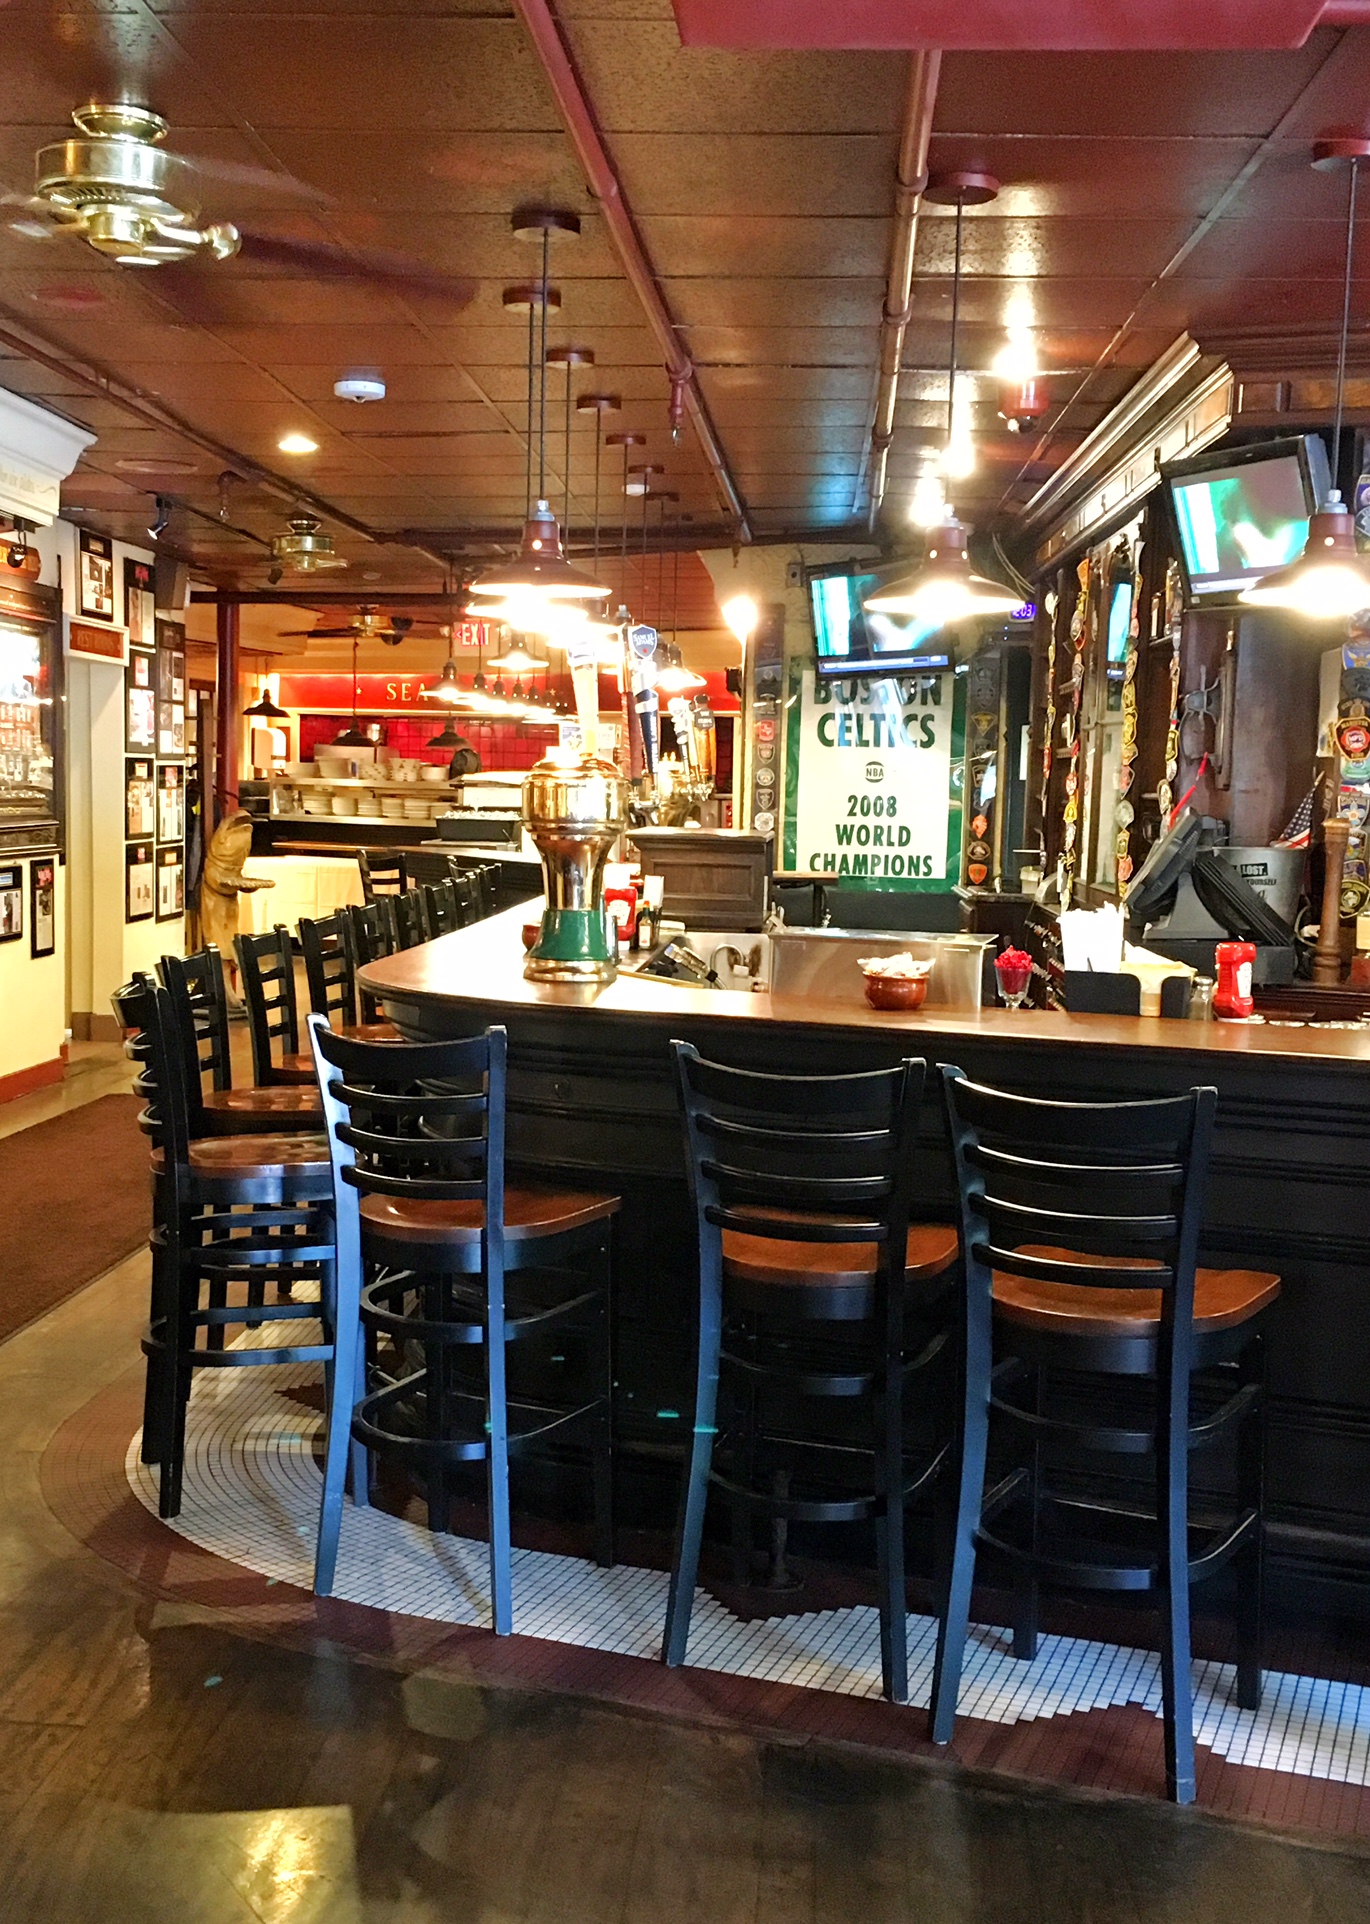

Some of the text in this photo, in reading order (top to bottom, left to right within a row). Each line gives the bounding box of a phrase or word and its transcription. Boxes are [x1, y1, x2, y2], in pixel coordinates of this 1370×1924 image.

[461, 623, 490, 646] EXIT
[814, 674, 942, 706] BOSON
[866, 768, 884, 778] NBA
[847, 795, 898, 818] 2008
[835, 824, 911, 847] WORLD
[809, 853, 933, 877] CHAMPIONS
